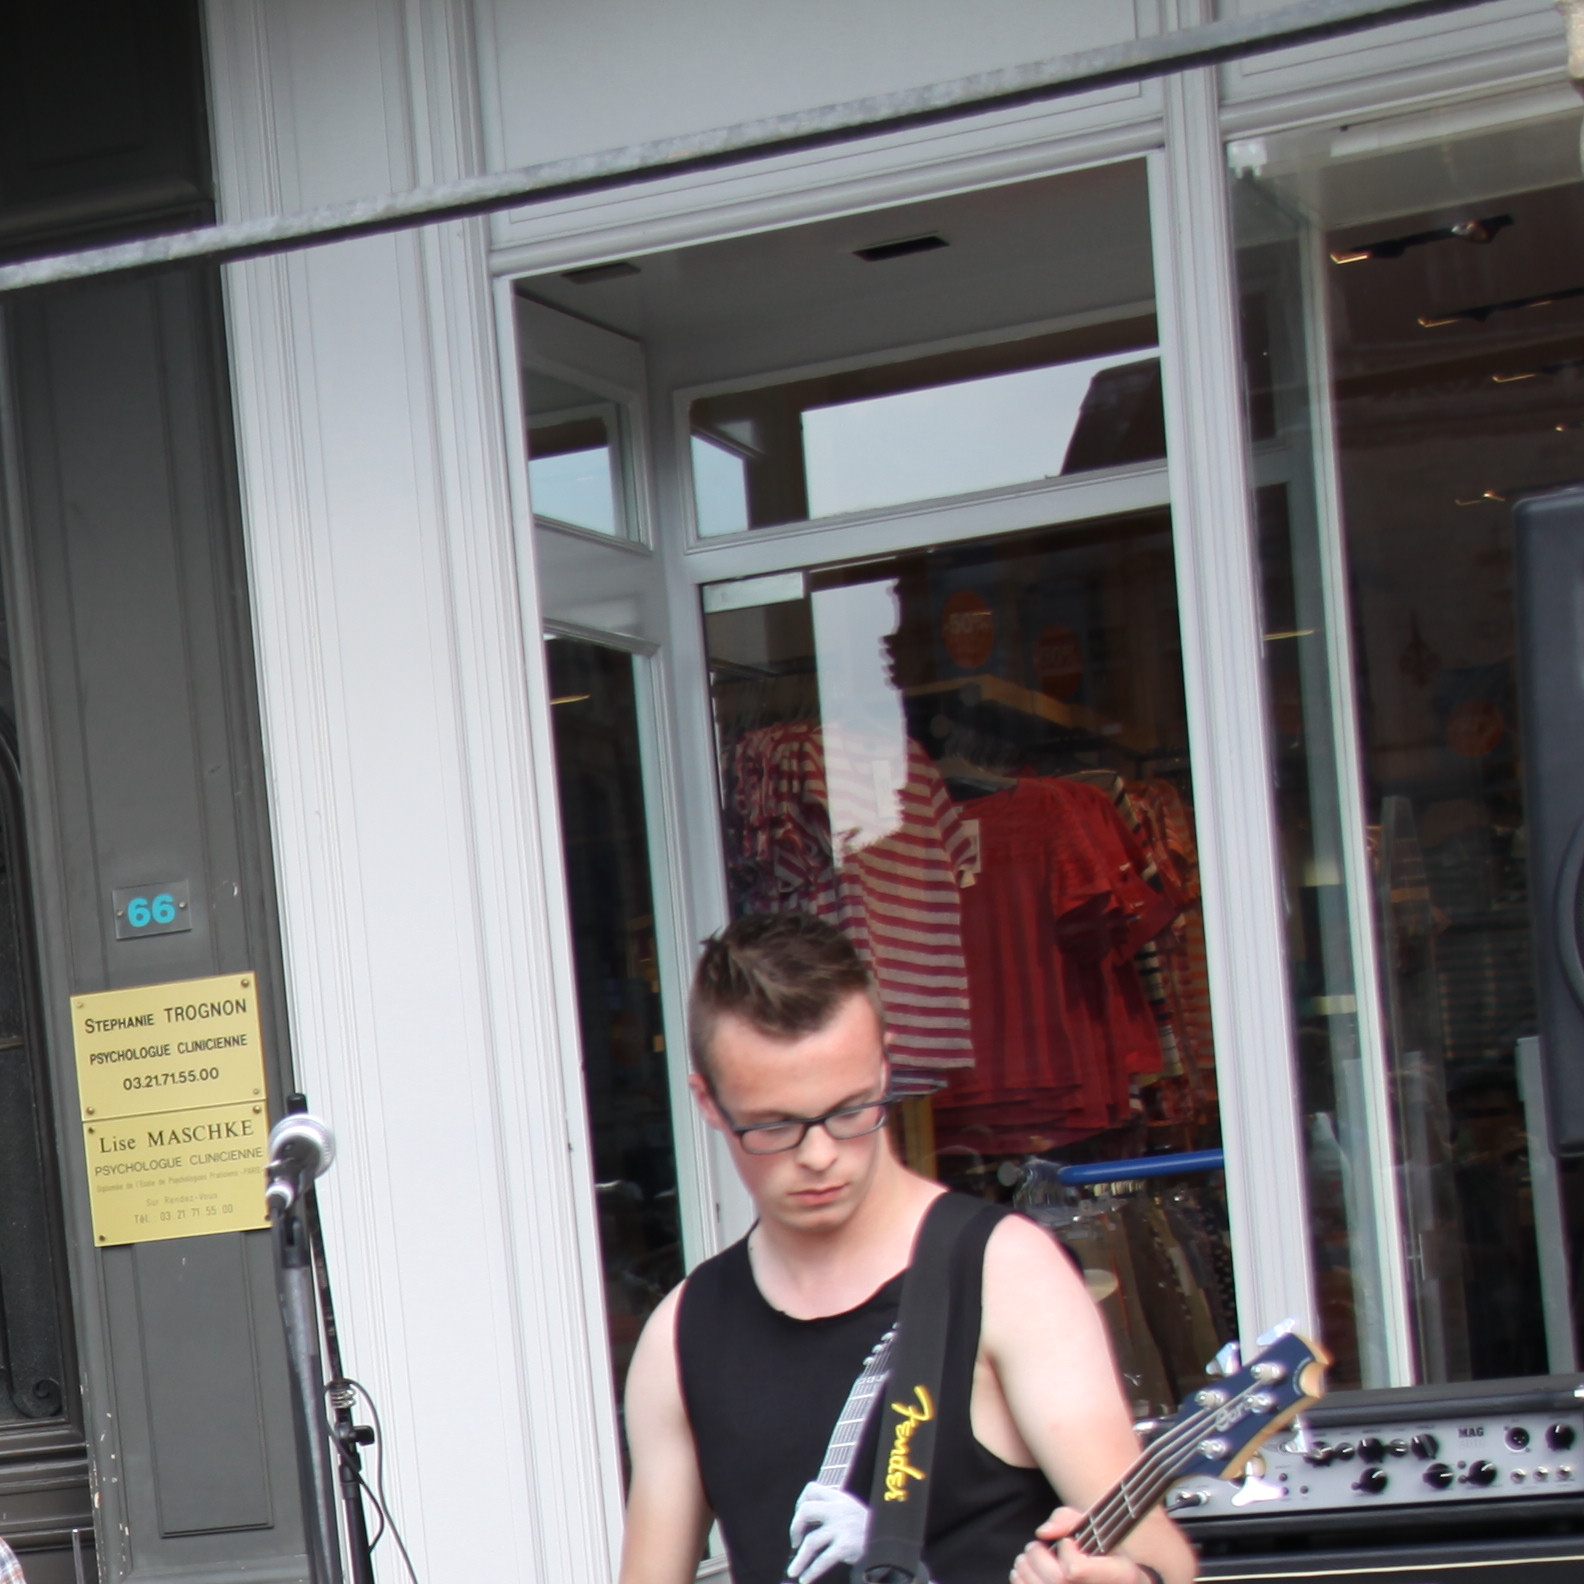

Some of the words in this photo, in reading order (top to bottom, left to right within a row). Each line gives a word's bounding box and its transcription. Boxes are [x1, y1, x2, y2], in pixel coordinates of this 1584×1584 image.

[127, 893, 176, 928] 66
[84, 1013, 155, 1034] STEPHANIE
[163, 999, 247, 1024] TROGNON
[89, 1044, 171, 1066] PSYCHOLOGUE
[177, 1034, 247, 1054] CLINICIENNE
[123, 1067, 219, 1091] 03.21.71.55.00
[99, 1135, 136, 1153] Lise
[147, 1119, 255, 1148] MASCHKE
[94, 1156, 182, 1176] PSYCHOLOGUE
[189, 1147, 263, 1166] CLINICIENNE
[160, 1211, 172, 1222] 03
[883, 1385, 936, 1503] Fender
[1457, 1427, 1485, 1439] MAG
